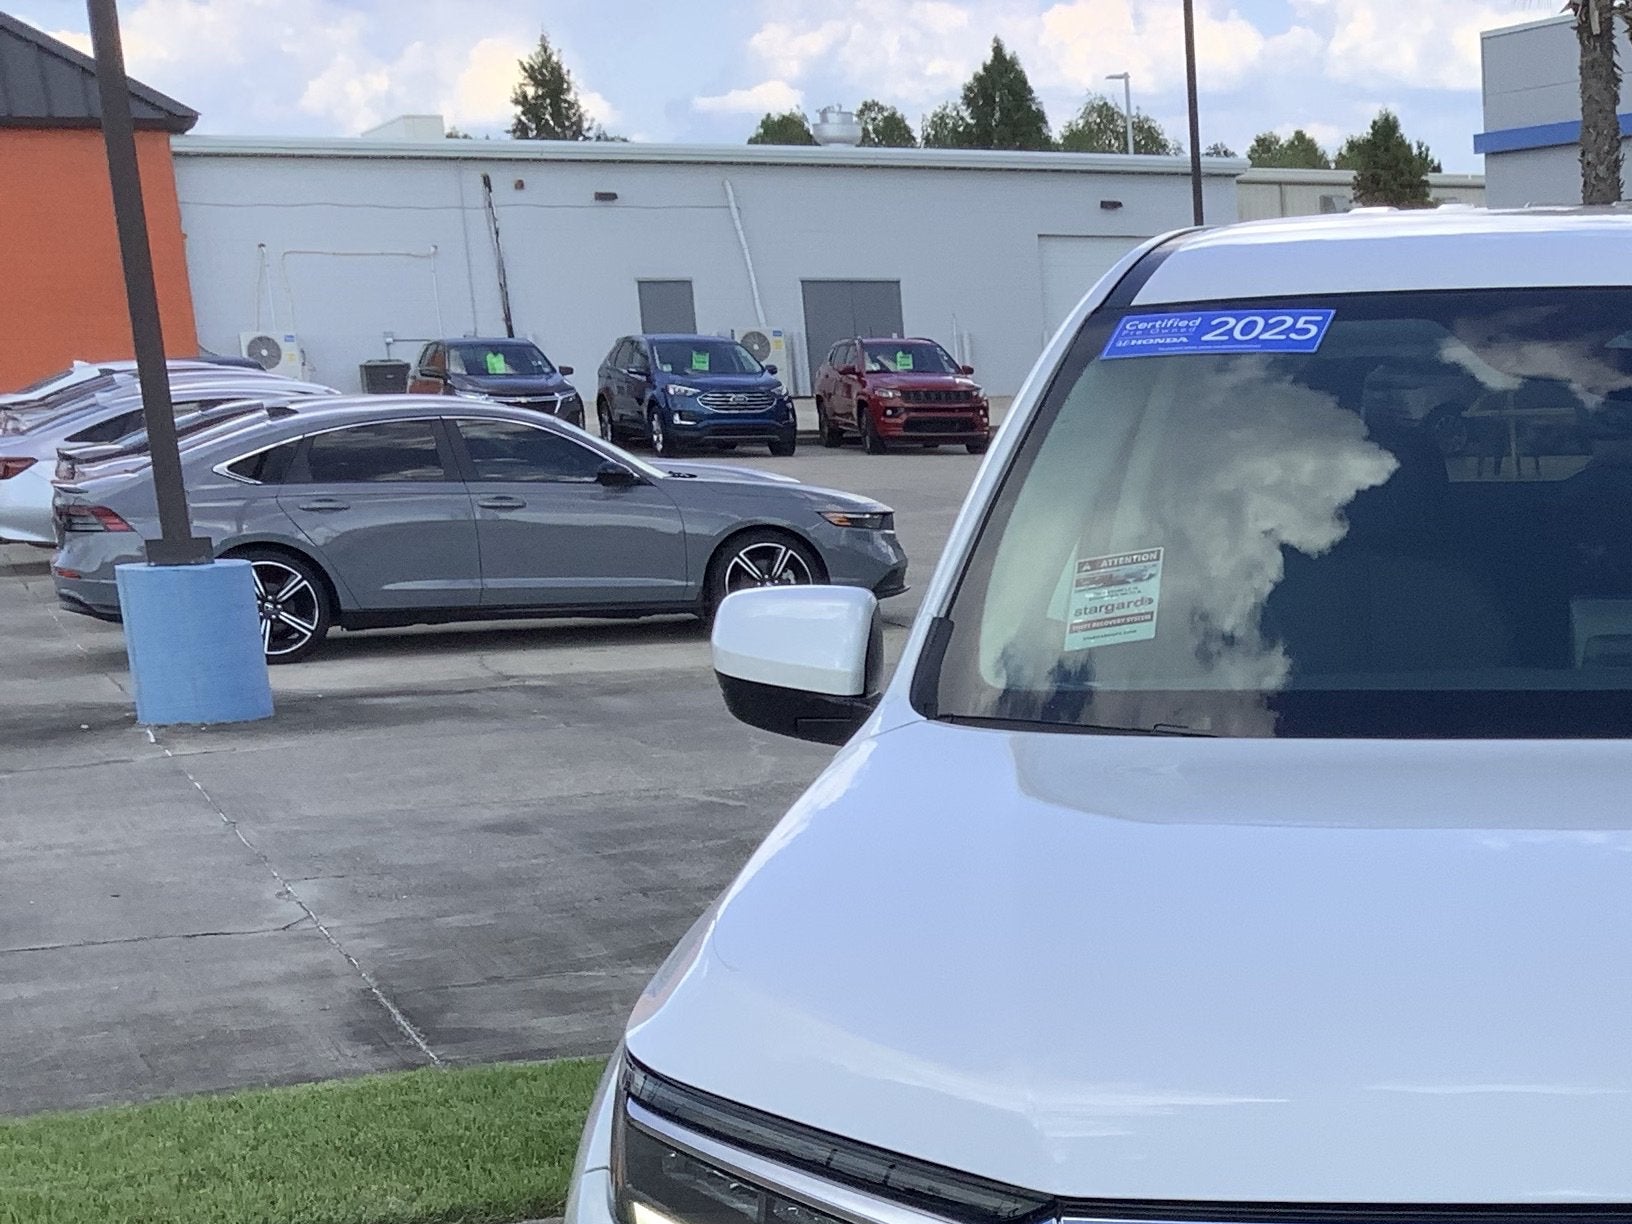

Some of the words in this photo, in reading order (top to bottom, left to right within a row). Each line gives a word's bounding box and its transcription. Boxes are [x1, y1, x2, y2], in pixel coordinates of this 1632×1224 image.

[1125, 316, 1201, 330] Certified
[1201, 316, 1323, 341] 2025
[1130, 336, 1189, 345] HONDA
[1101, 552, 1157, 567] ATTENTION
